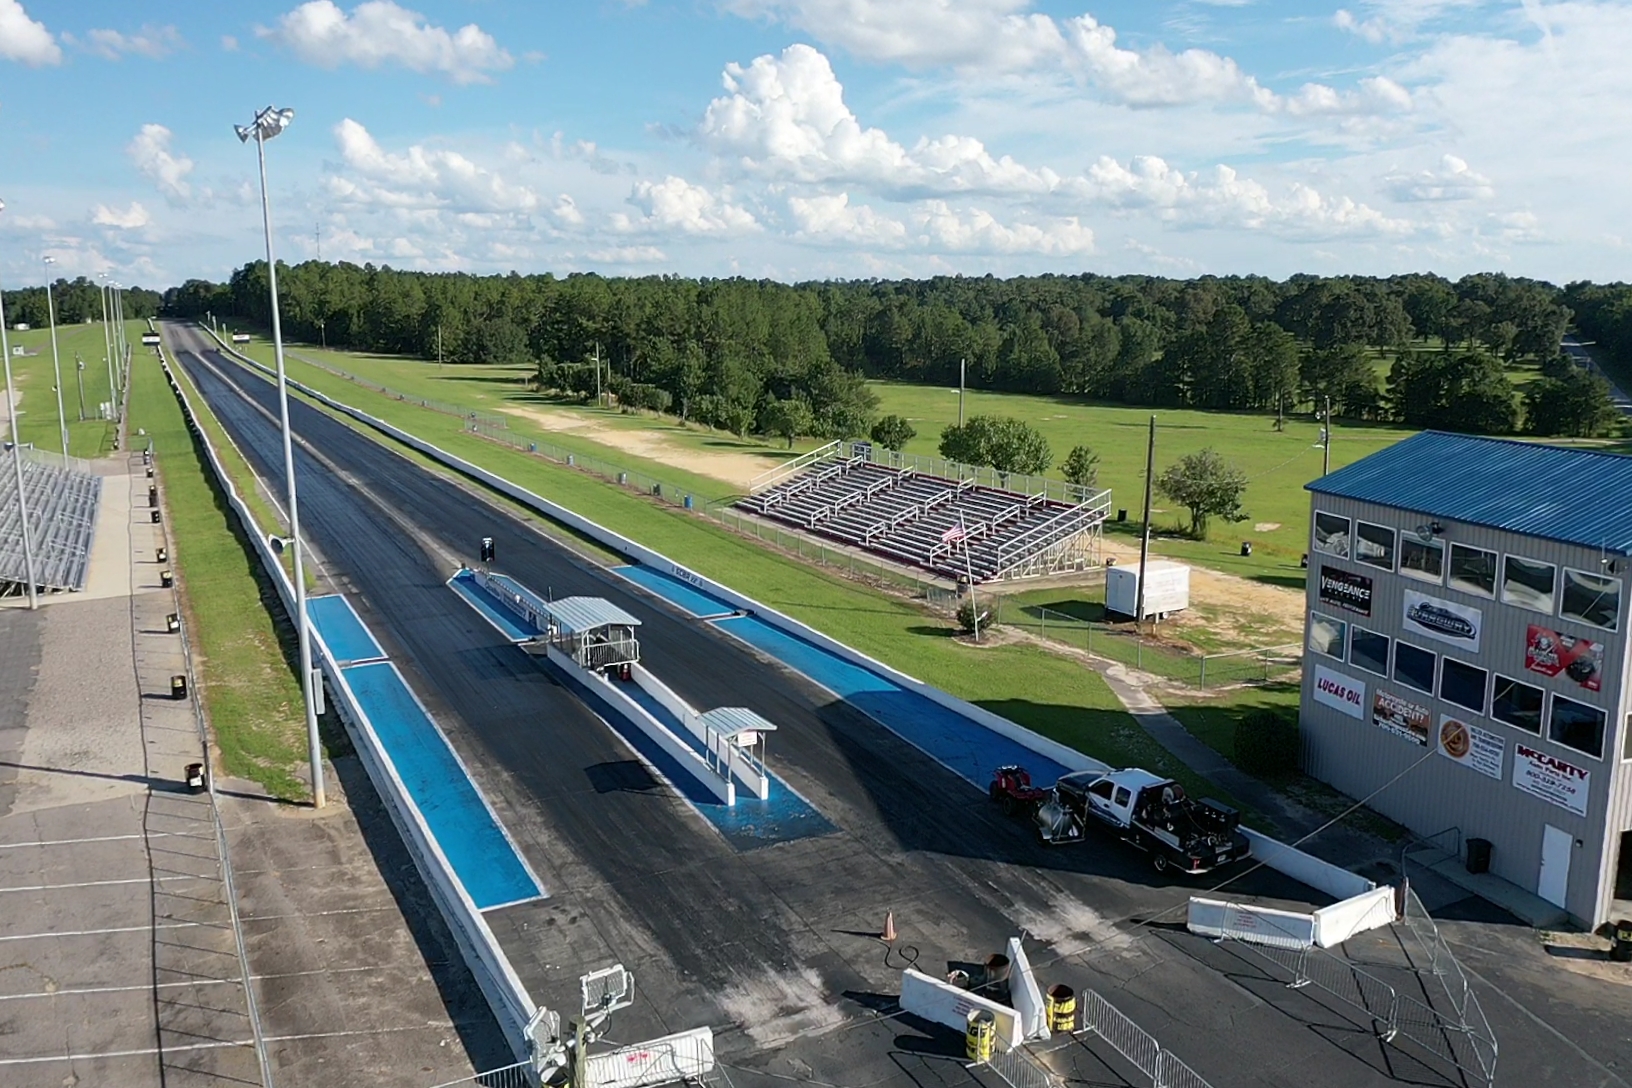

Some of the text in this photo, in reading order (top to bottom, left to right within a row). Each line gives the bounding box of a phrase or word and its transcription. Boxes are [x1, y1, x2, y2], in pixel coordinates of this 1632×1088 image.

[1322, 575, 1370, 599] VENGEANCE
[1318, 677, 1361, 705] LUCAS OIL
[1378, 697, 1425, 724] ACCIDENT?
